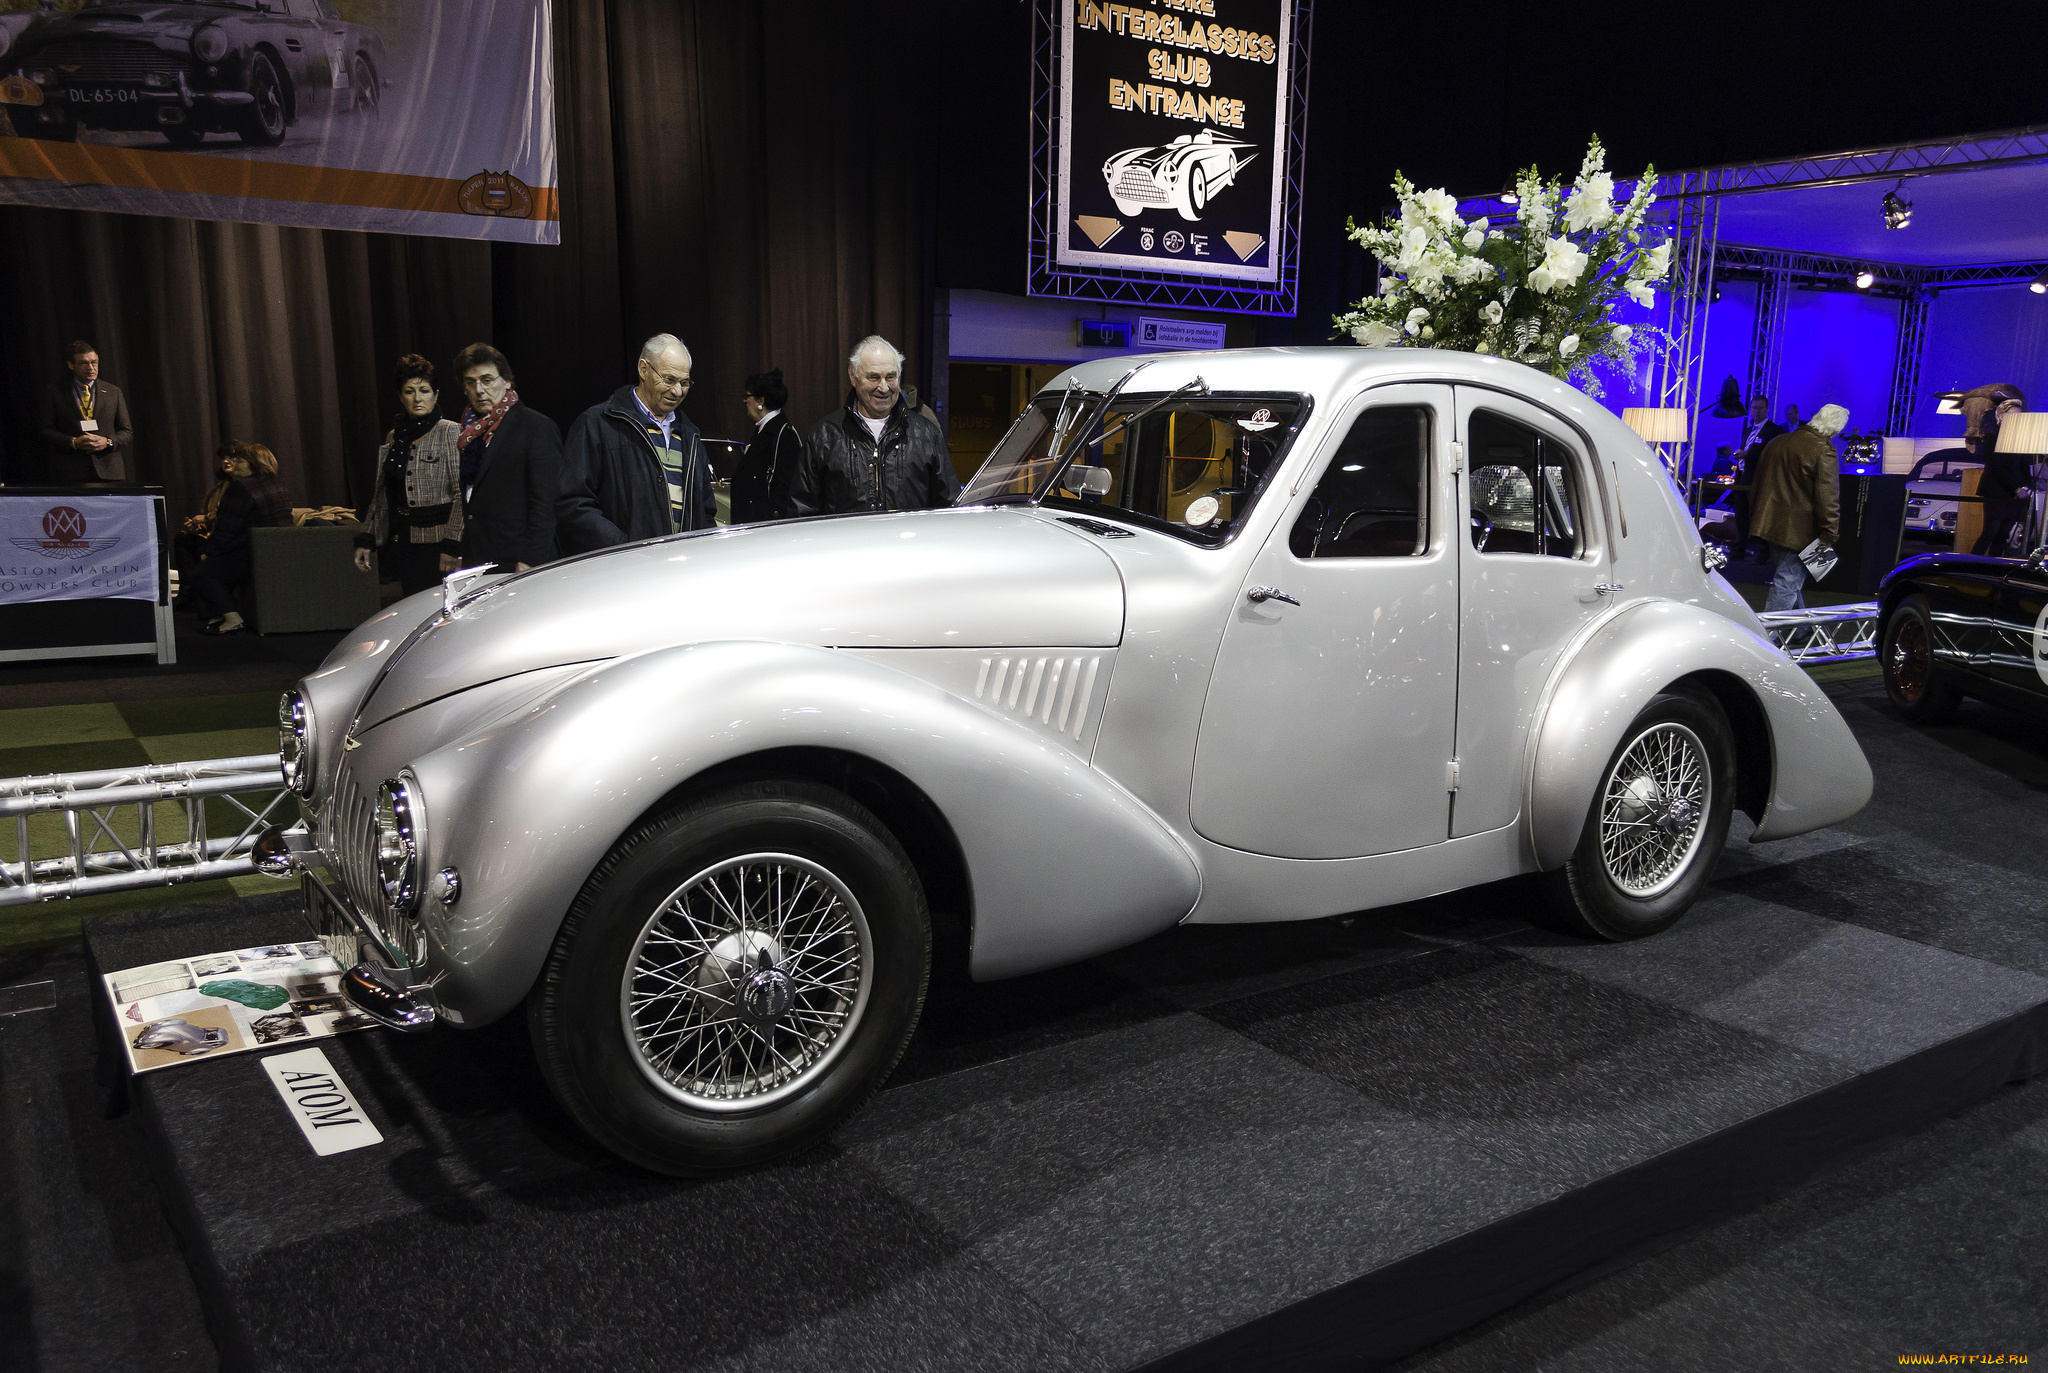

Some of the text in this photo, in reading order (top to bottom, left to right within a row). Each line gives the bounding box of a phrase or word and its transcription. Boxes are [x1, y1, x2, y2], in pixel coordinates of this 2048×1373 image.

[1077, 0, 1275, 63] INTERCLASSICS
[1147, 48, 1211, 88] CLUB
[1109, 78, 1245, 129] ENTRANCE
[463, 179, 484, 199] TULPEN
[1191, 337, 1218, 345] hoofdentree
[70, 565, 140, 575] MARTIN
[2, 579, 138, 592] OWNERS CLUB
[280, 1070, 363, 1130] ATOM
